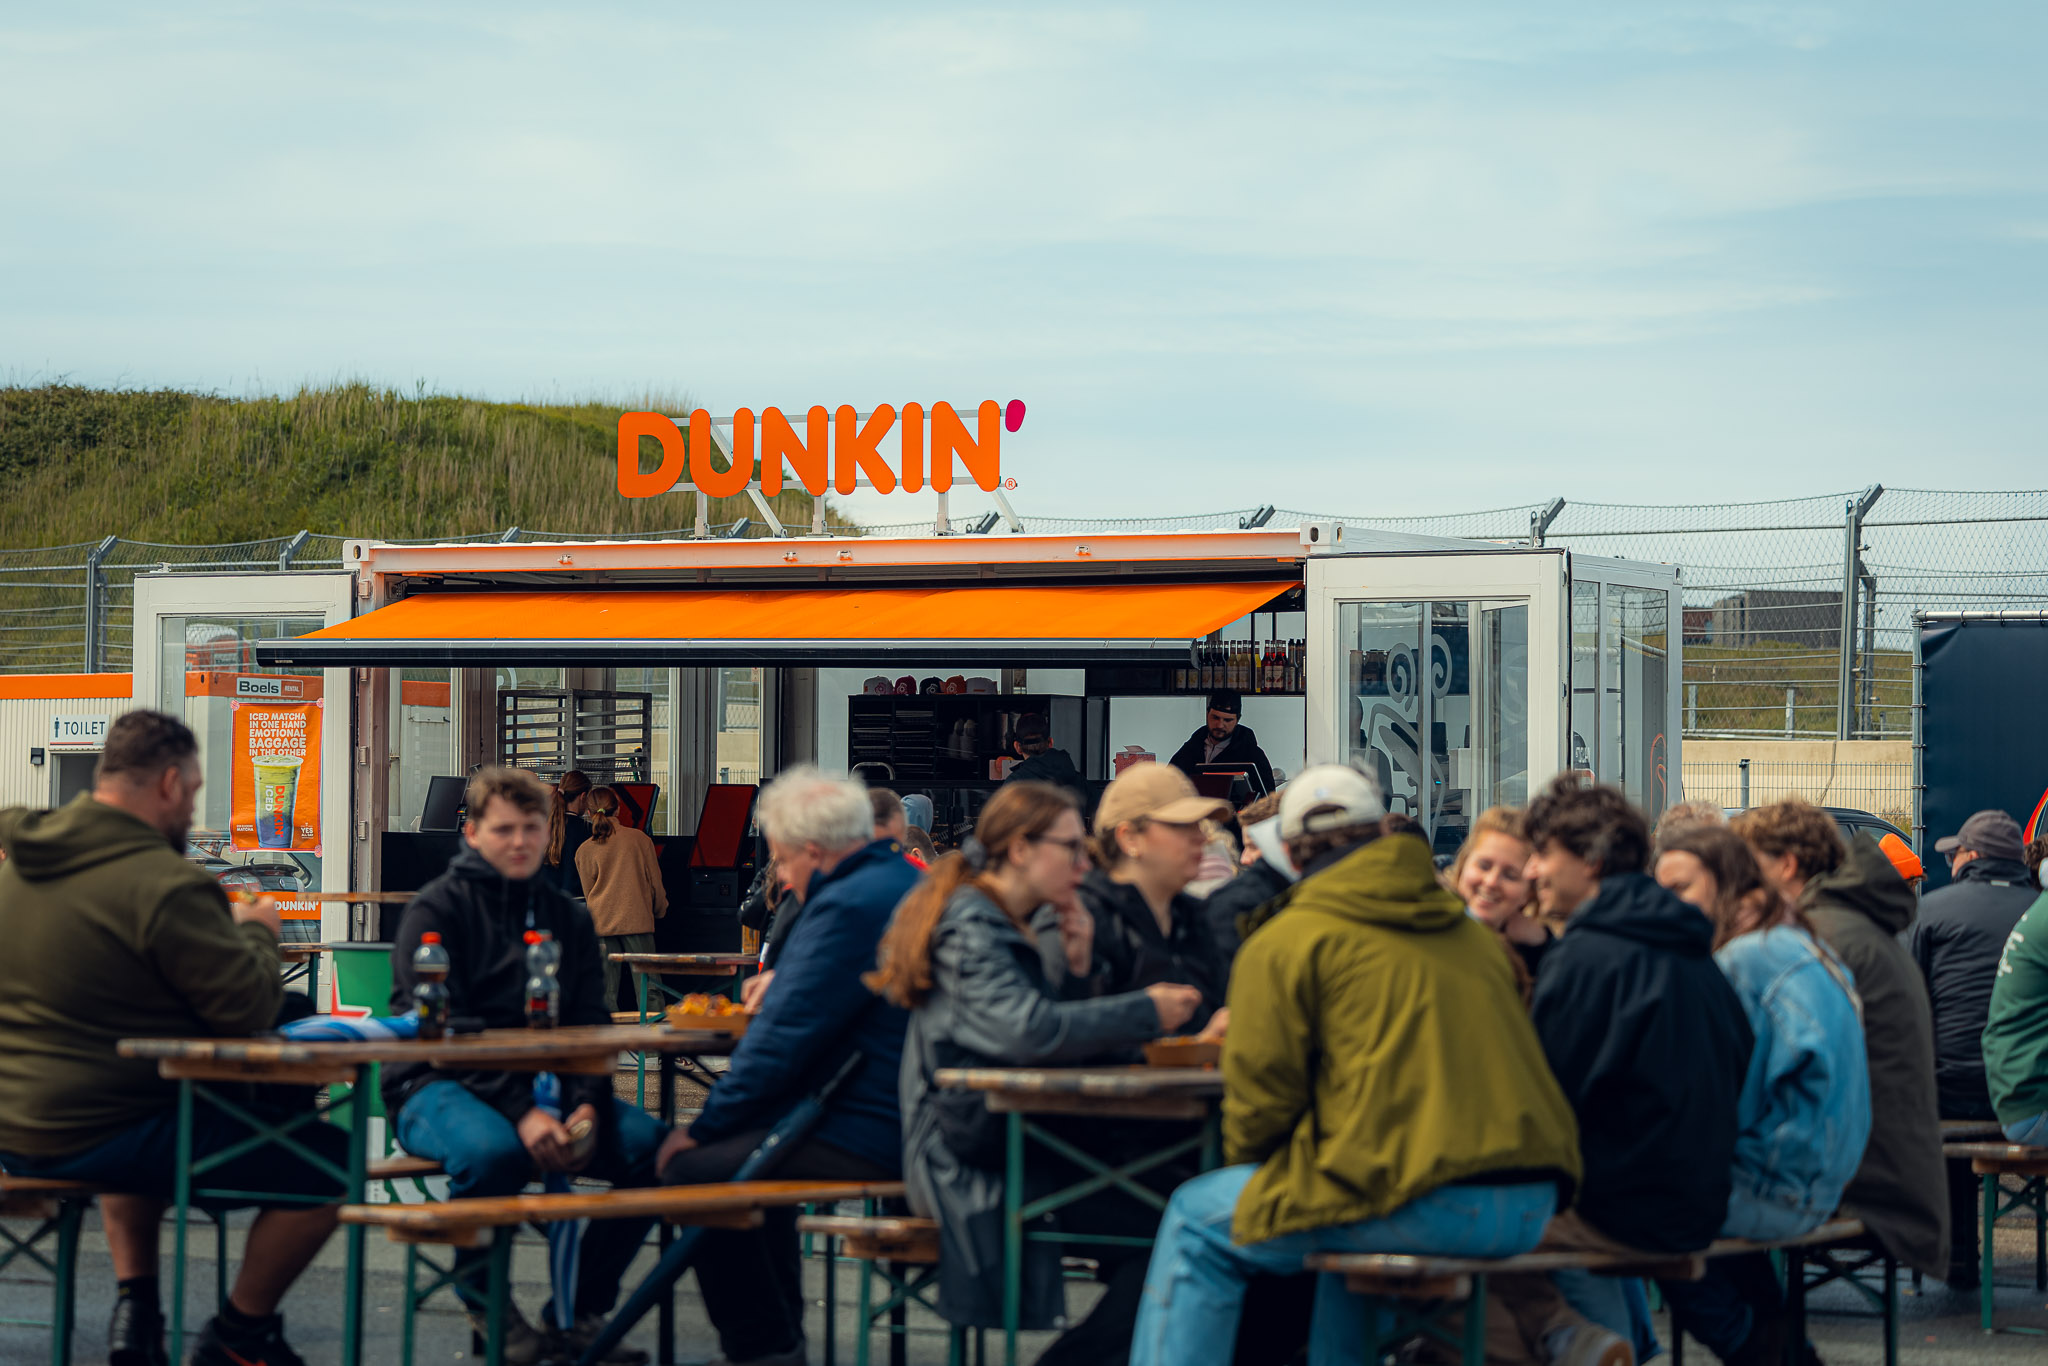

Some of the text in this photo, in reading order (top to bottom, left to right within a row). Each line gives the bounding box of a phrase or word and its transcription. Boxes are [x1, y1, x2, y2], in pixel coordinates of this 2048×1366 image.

[617, 399, 1026, 498] DUNKIN'
[239, 681, 279, 694] Boels
[249, 713, 307, 721] ICED MATCHA
[64, 721, 106, 735] TOILET
[249, 720, 307, 728] IN ONE HAND
[249, 729, 307, 737] EMOTIONAL
[249, 738, 307, 748] BAGGAGE
[249, 749, 258, 757] IN
[277, 749, 307, 757] OTHER
[265, 785, 274, 811] ICED
[273, 785, 285, 838] DUNKIN'
[275, 901, 319, 911] DUNKIN'
